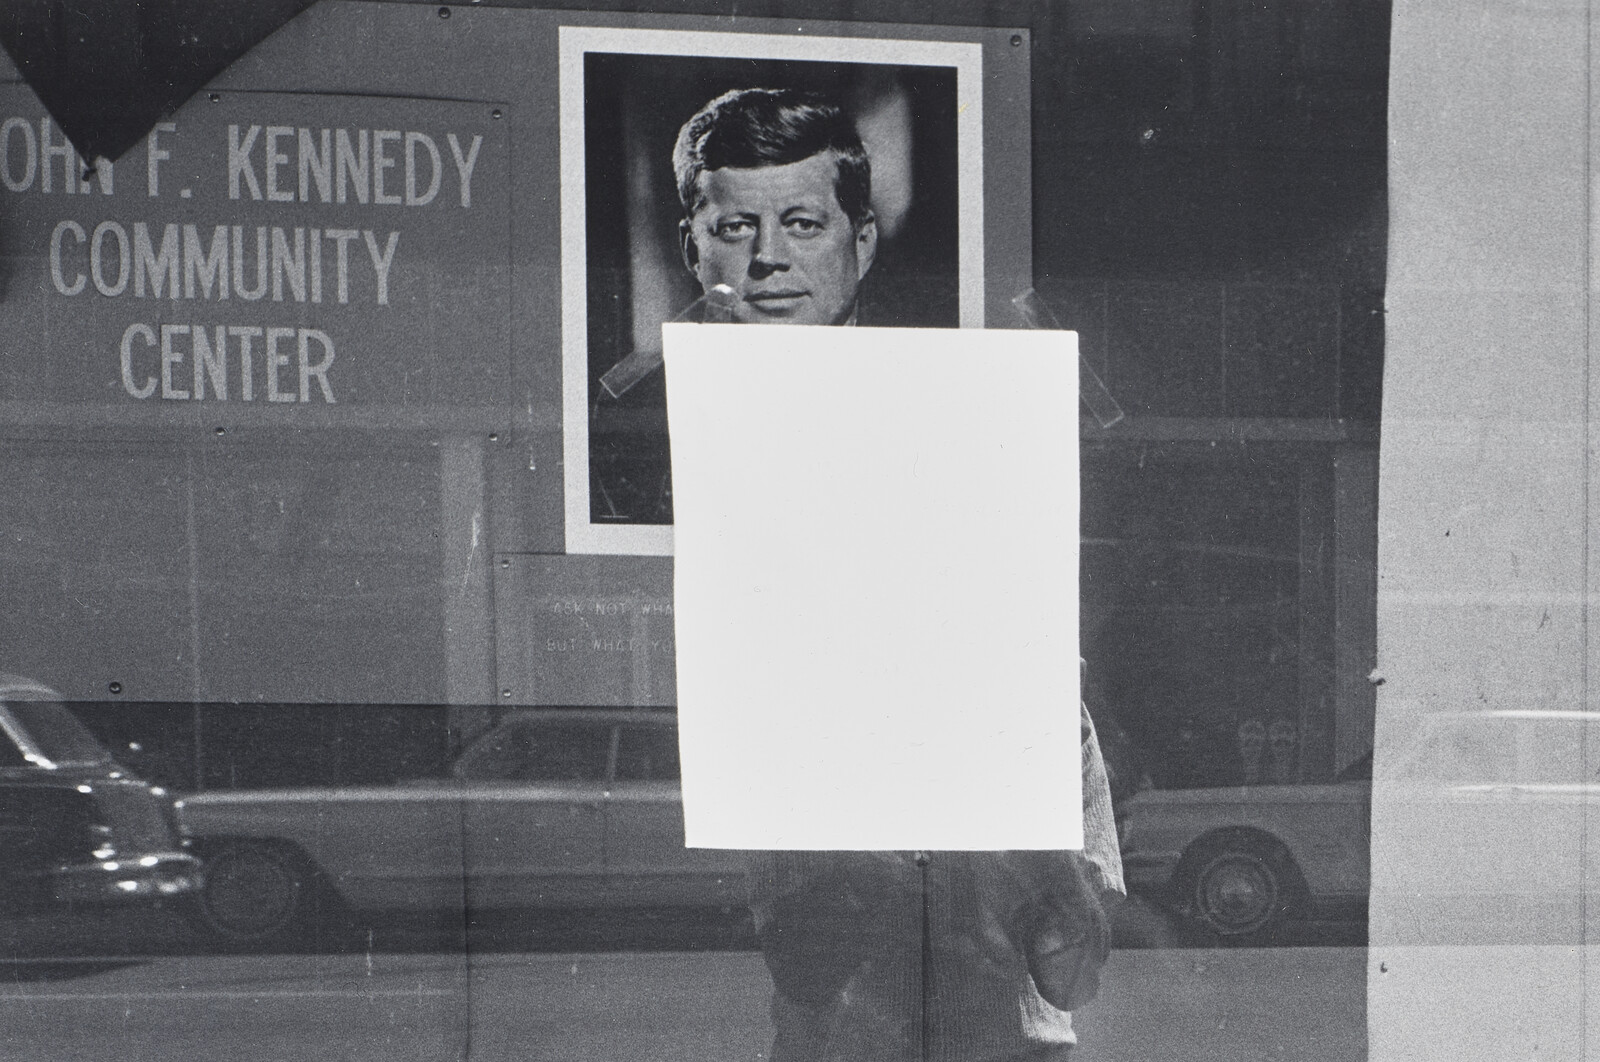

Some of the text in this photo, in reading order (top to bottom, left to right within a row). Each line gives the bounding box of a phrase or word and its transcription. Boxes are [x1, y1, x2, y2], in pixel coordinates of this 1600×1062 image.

[147, 121, 193, 199] F.
[228, 122, 483, 208] KENNEDY
[49, 220, 400, 305] COMMUNITY
[120, 322, 337, 403] CENTER
[595, 601, 627, 616] NOT
